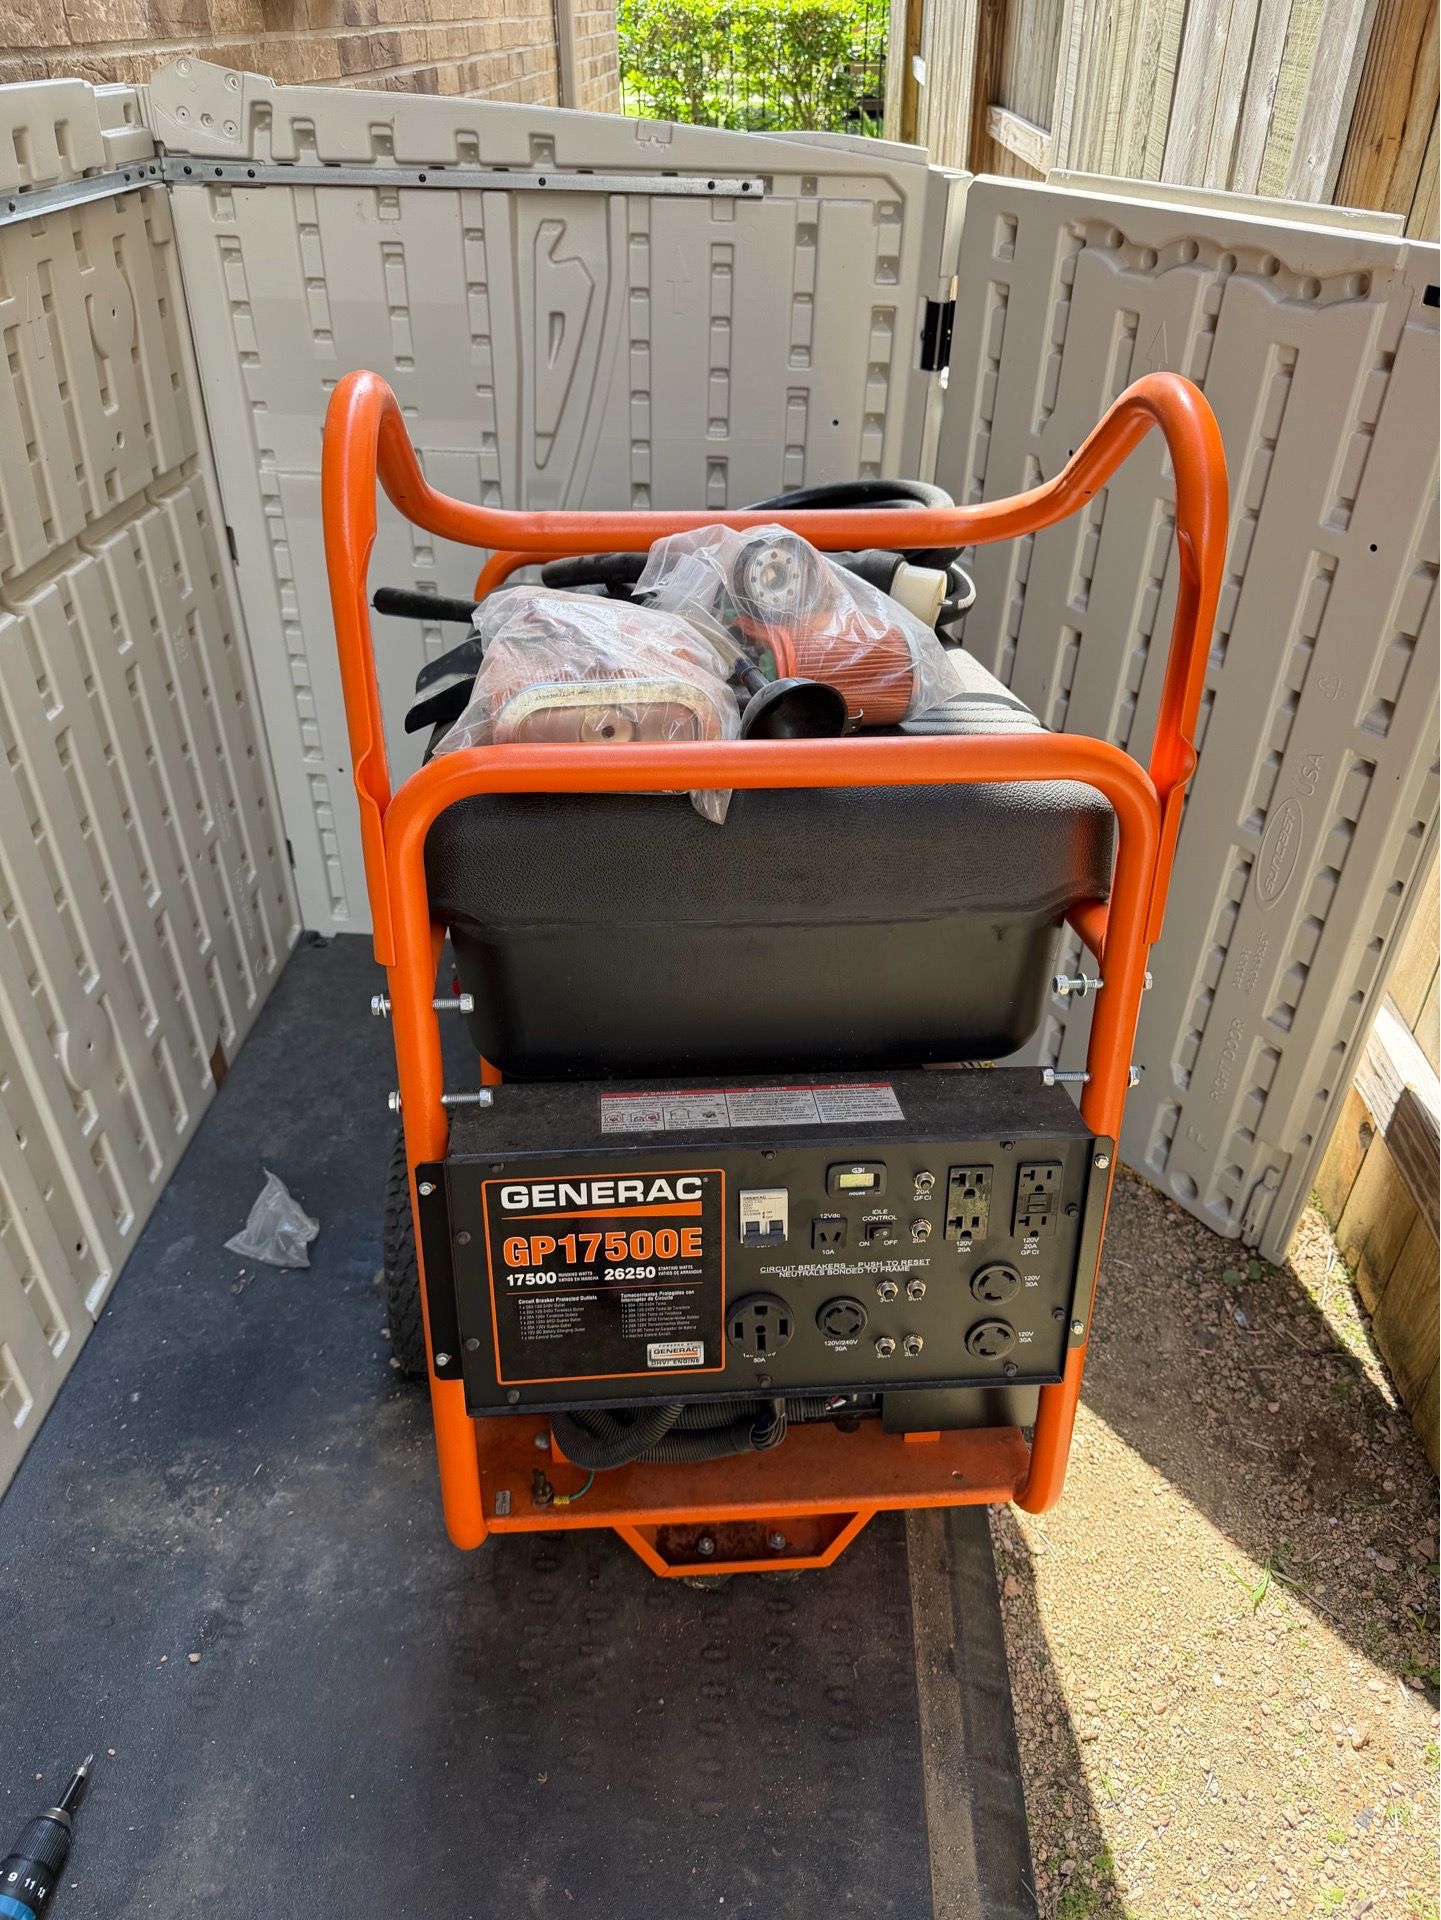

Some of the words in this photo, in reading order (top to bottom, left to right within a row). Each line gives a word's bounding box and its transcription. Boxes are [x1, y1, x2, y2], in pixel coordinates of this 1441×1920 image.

[1301, 754, 1325, 797] USA
[1223, 1016, 1245, 1062] DOOR
[501, 1177, 702, 1210] GENERAC
[862, 1214, 898, 1222] CONTROL
[503, 1227, 702, 1267] GP17500E
[604, 1266, 656, 1280] 26250
[760, 1265, 796, 1274] CIRCUIT
[798, 1262, 846, 1271] BREAKERS
[901, 1258, 930, 1266] RESET
[779, 1270, 824, 1278] NEUTRALS
[827, 1268, 864, 1276] BONDED
[880, 1265, 910, 1273] FRAME
[506, 1272, 556, 1286] 17500
[8, 1872, 18, 1882] 9
[25, 1878, 36, 1890] 11
